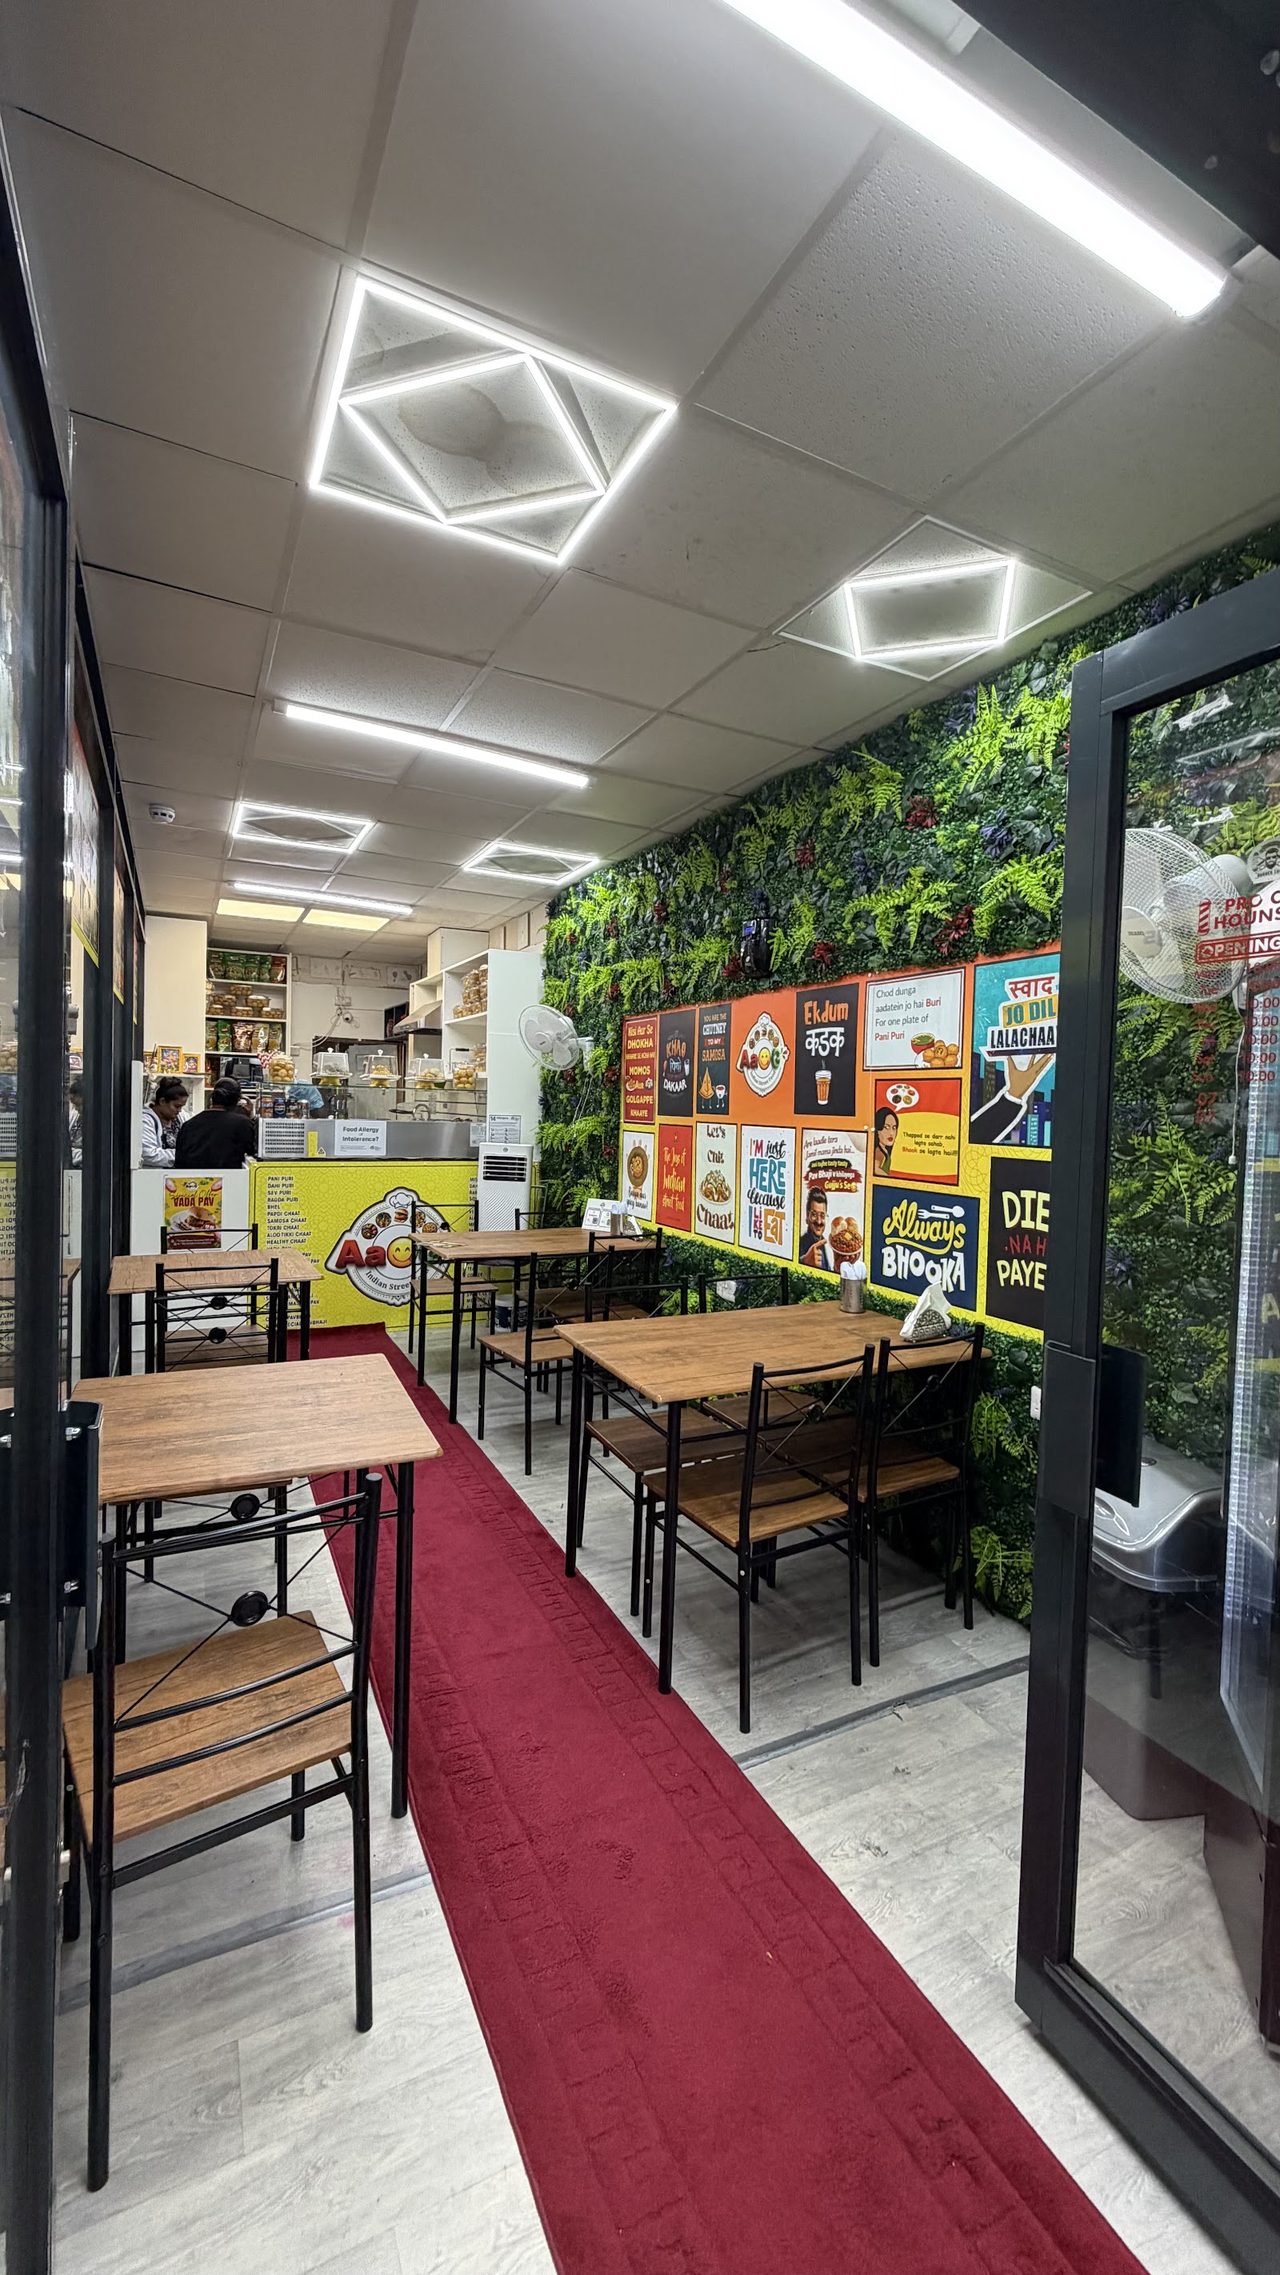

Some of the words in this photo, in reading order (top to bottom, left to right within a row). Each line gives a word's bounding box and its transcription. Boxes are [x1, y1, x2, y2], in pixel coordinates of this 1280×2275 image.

[1225, 893, 1263, 912] PRO
[876, 986, 894, 999] Chod
[895, 984, 916, 998] dunga
[913, 997, 925, 1009] hai
[925, 995, 942, 1007] Buri
[803, 1000, 849, 1025] Ekdum
[875, 1018, 886, 1028] For
[887, 1017, 901, 1026] one
[902, 1014, 919, 1028] plate
[920, 1013, 929, 1023] of
[1007, 1004, 1024, 1026] JO
[702, 1022, 727, 1036] CHUTNEY
[874, 1031, 890, 1041] Pani
[890, 1030, 905, 1041] Puri
[990, 1025, 1057, 1049] LALACHAA
[627, 1038, 654, 1050] DHOKHA
[702, 1048, 726, 1062] SAMOSA
[629, 1065, 651, 1076] MOMOS
[663, 1078, 688, 1093] DAKAAR
[626, 1094, 654, 1105] GOLGAPPE
[750, 1138, 764, 1157] I'M
[764, 1139, 787, 1160] just
[749, 1158, 786, 1196] HERE
[173, 1196, 196, 1207] VADA
[198, 1196, 215, 1207] PAV
[1001, 1190, 1051, 1233] DIE
[882, 1199, 967, 1255] Always
[882, 1244, 966, 1293] BHOOKA
[996, 1258, 1048, 1291] PAYE
[365, 1270, 388, 1289] Indian
[388, 1281, 411, 1291] Stree
